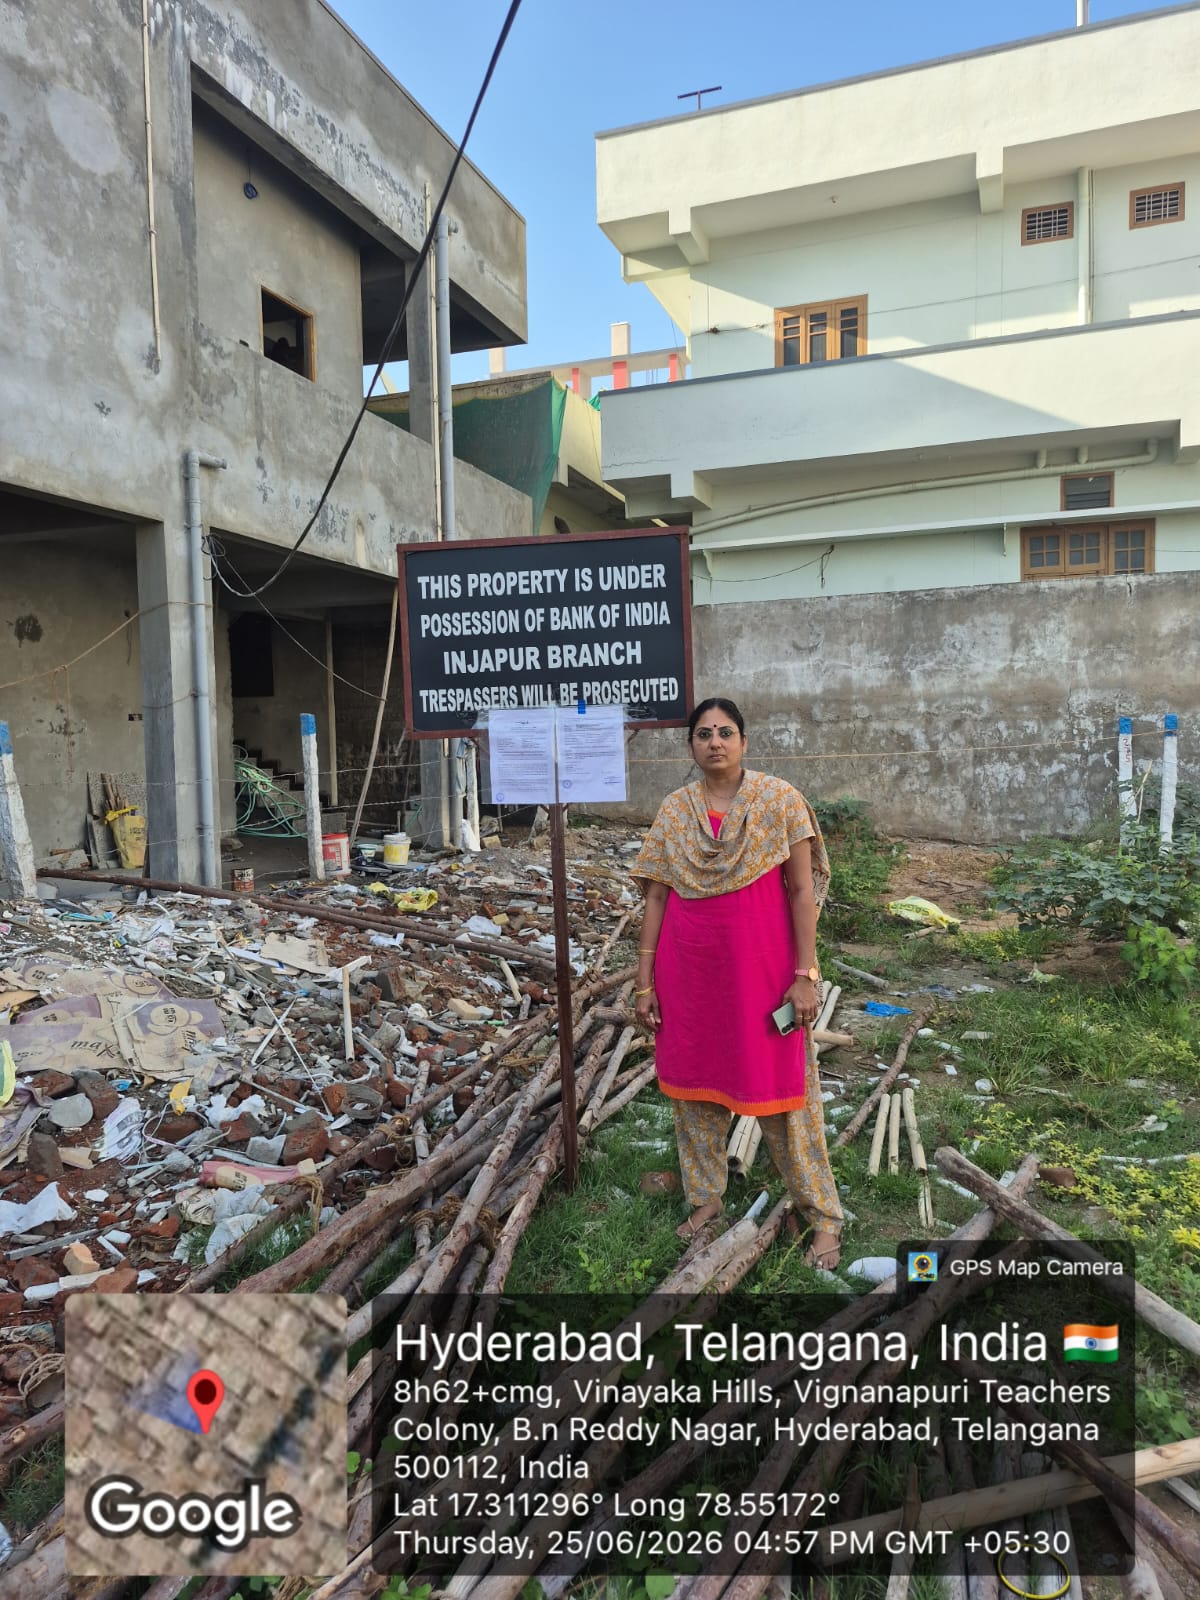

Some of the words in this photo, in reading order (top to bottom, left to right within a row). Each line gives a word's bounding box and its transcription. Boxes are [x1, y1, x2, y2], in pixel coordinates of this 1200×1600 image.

[418, 575, 462, 599] THIS
[467, 568, 569, 598] PROPERTY
[575, 567, 593, 592] IS
[598, 563, 667, 592] UNDER
[420, 608, 520, 638] POSSESSION
[524, 607, 545, 632] OF
[549, 605, 595, 631] BANK
[599, 603, 620, 628] OF
[625, 601, 671, 627] INDIA
[443, 646, 541, 675] INJAPUR
[547, 640, 642, 669] BRANCH
[419, 686, 518, 713] TRESPASSERS
[521, 683, 554, 707] WILL
[560, 681, 579, 706] BE
[582, 677, 679, 705] PROSECUTED
